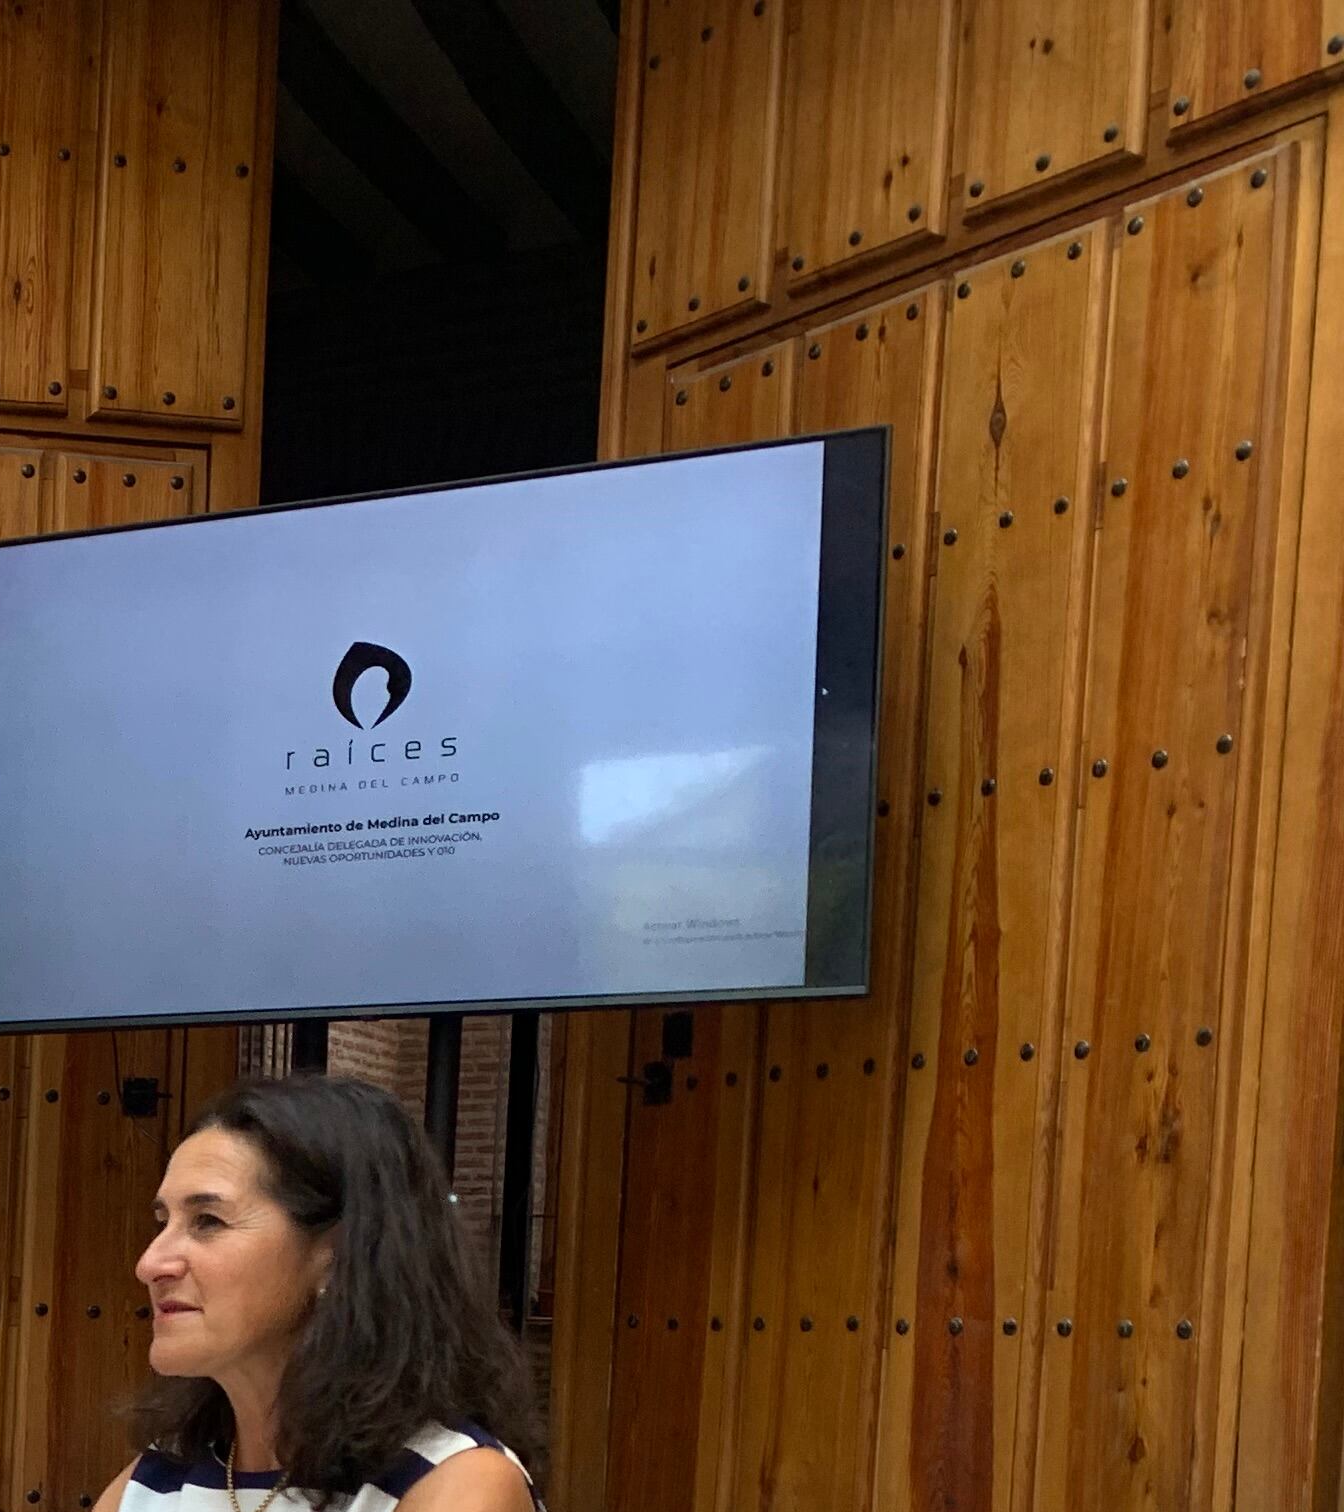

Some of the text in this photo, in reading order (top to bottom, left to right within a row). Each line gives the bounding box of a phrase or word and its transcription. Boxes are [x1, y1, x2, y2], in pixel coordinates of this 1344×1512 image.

[285, 737, 457, 770] raíces
[285, 773, 460, 796] MEDINA DEL CAMPO
[244, 810, 500, 840] Ayuntamiento de Medina del Campo
[258, 840, 325, 856] CONCEJALÍA
[327, 838, 387, 852] DELEGADA
[389, 836, 405, 847] DE
[283, 854, 327, 866] NUEVAS
[329, 848, 425, 864] OPORTUNIDADES
[427, 847, 436, 857] Y
